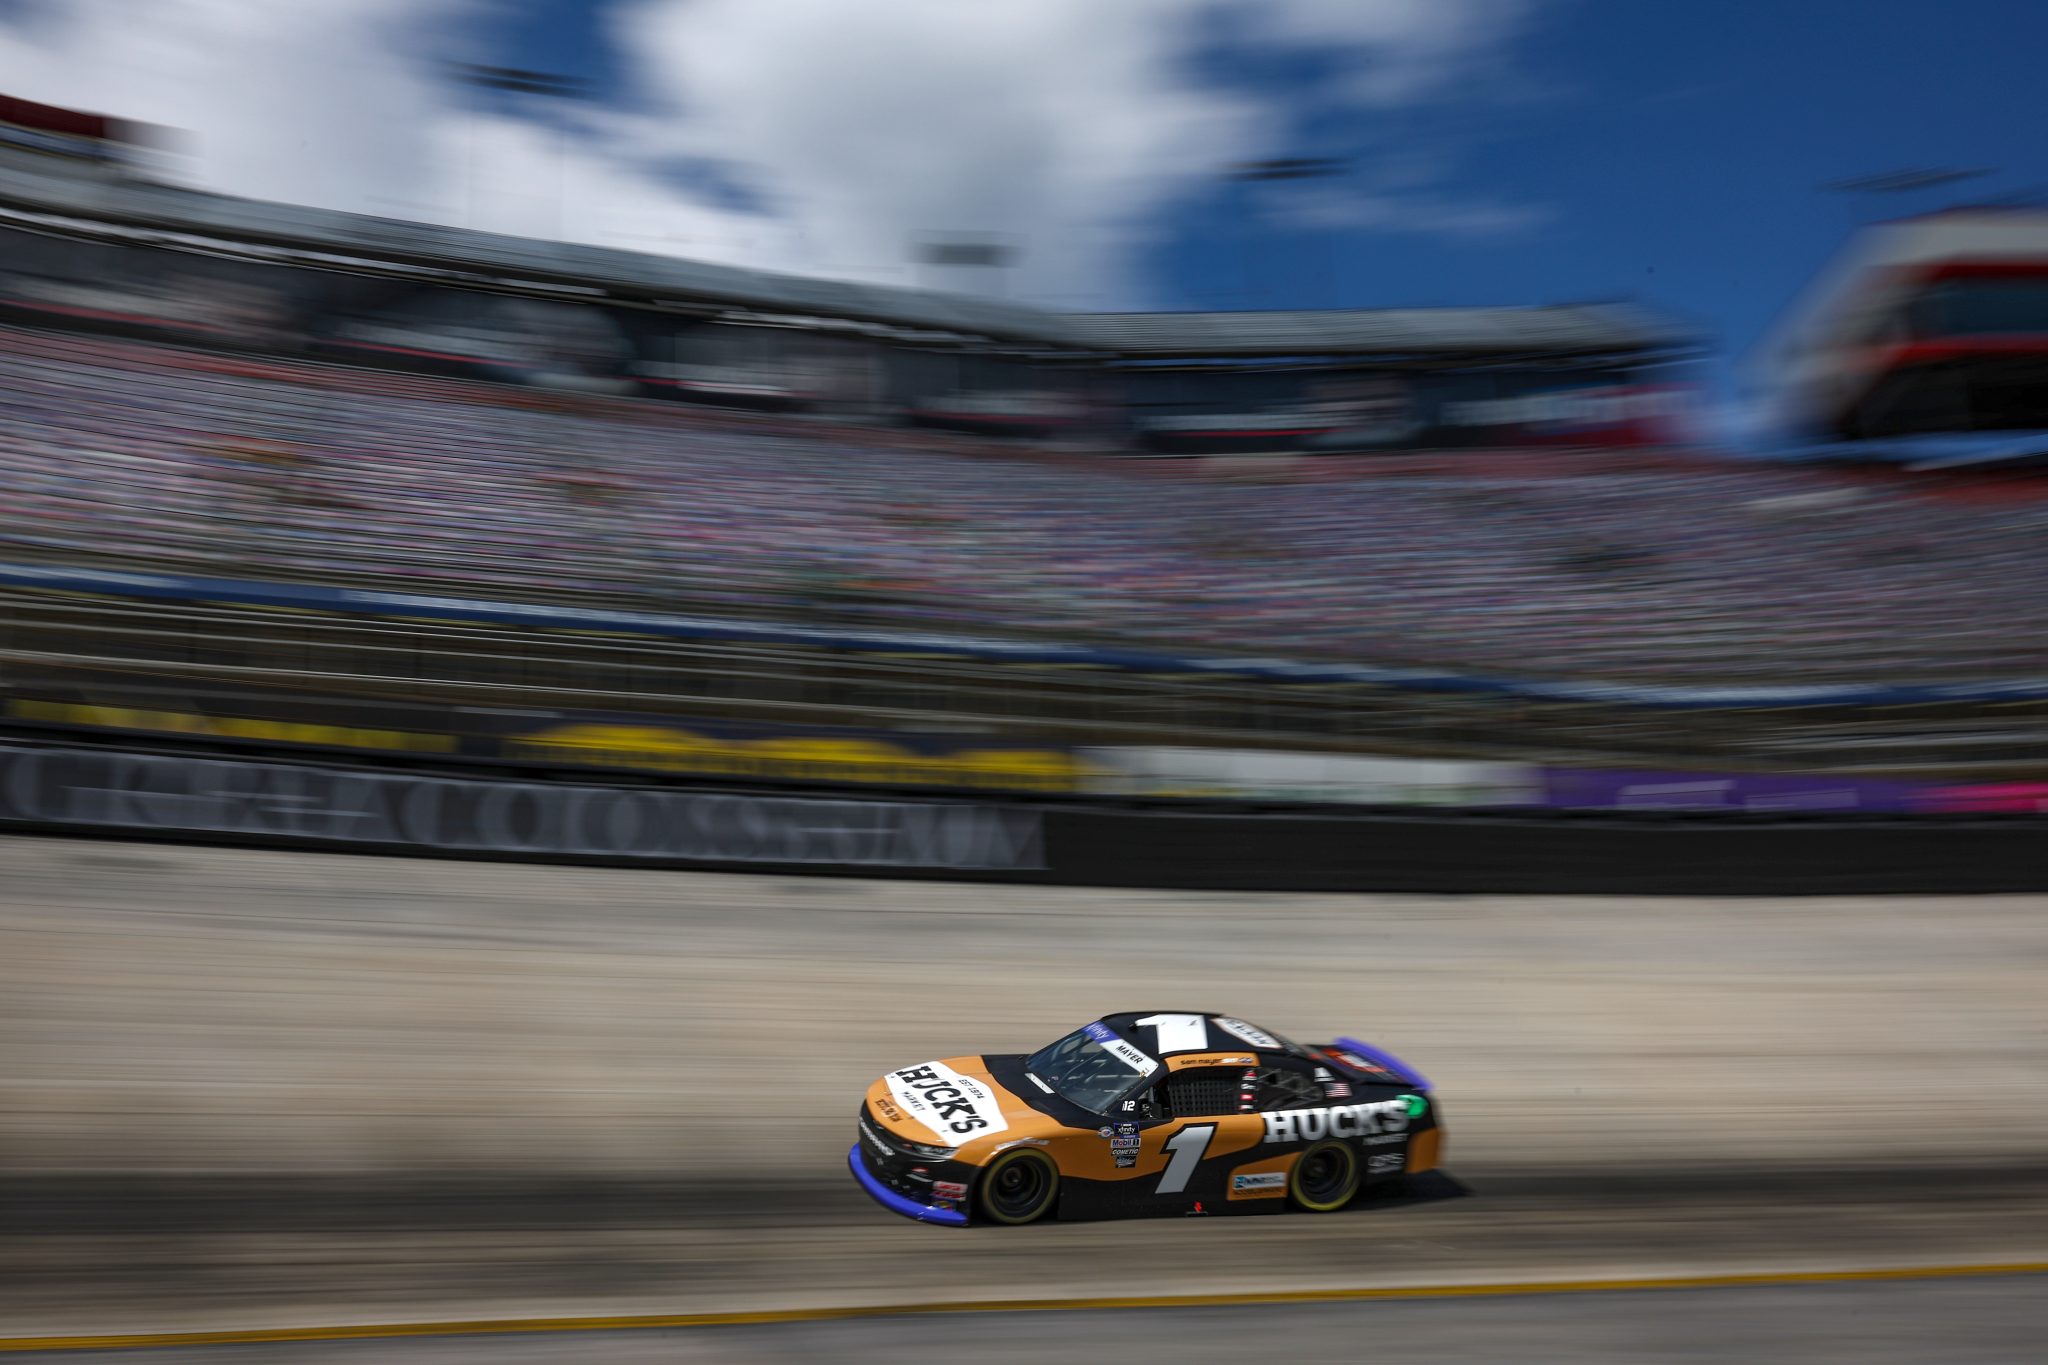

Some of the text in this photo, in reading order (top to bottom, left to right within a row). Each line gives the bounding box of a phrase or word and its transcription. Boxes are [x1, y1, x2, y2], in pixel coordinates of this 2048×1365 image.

[1134, 1014, 1208, 1054] 1
[1116, 1045, 1143, 1064] MAYER
[895, 1065, 988, 1133] HUCK'S
[902, 1091, 926, 1111] MARKET
[1122, 1100, 1135, 1111] 12
[1155, 1122, 1218, 1194] 1
